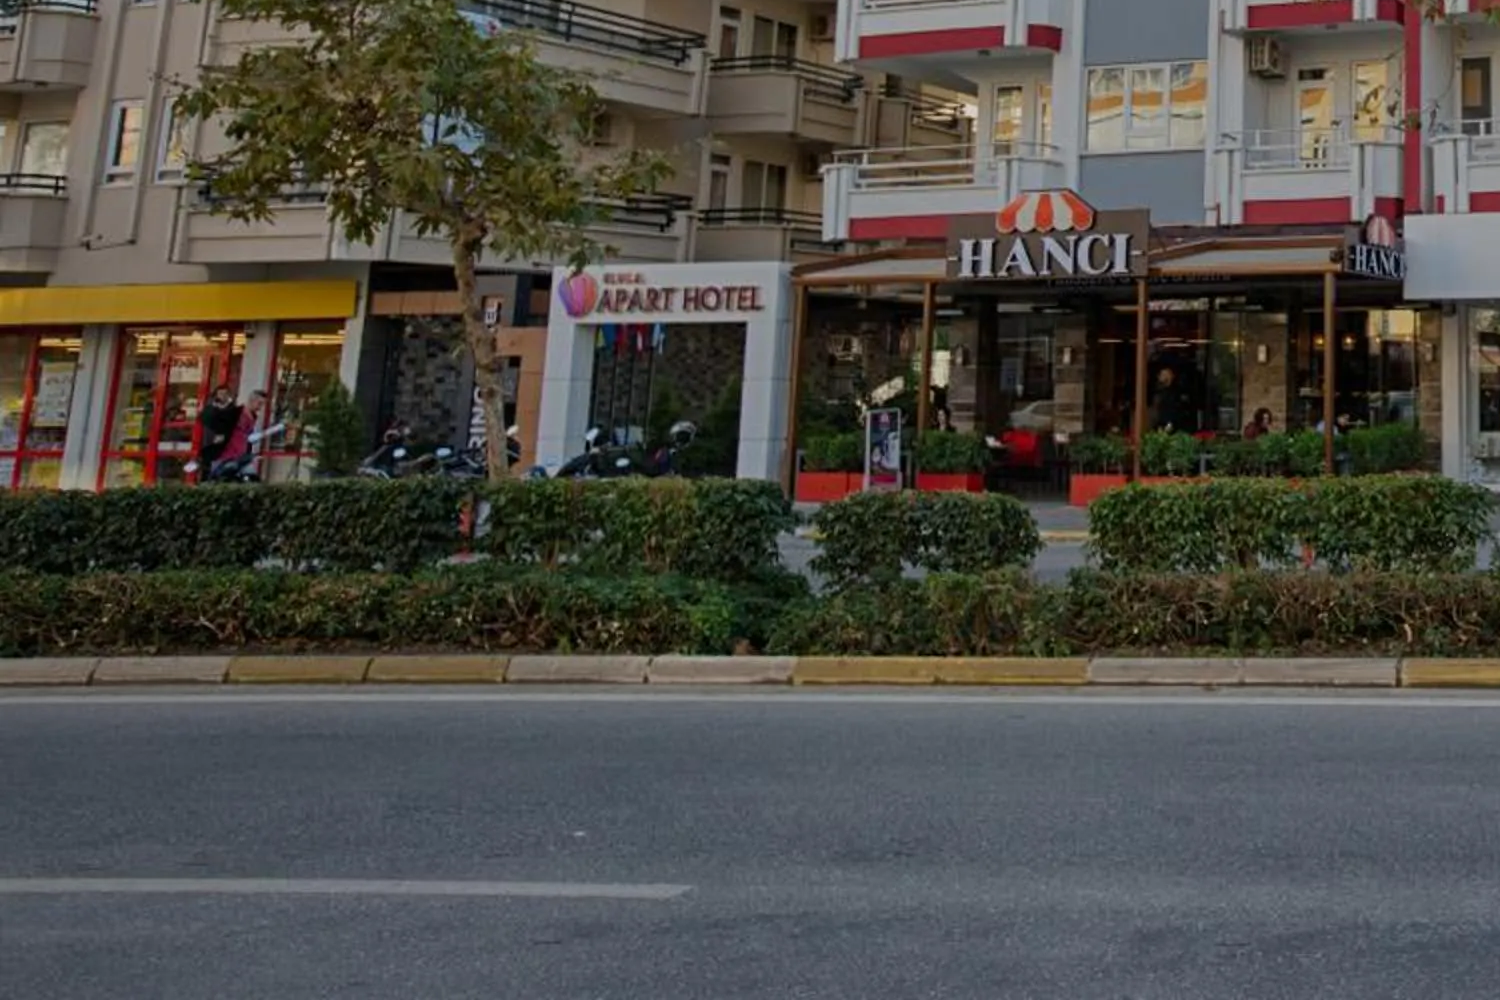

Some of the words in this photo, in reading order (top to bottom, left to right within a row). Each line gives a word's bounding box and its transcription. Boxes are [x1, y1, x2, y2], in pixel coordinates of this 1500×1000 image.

[958, 233, 1130, 278] HANCI
[596, 287, 676, 313] APART
[682, 286, 766, 312] HOTEL
